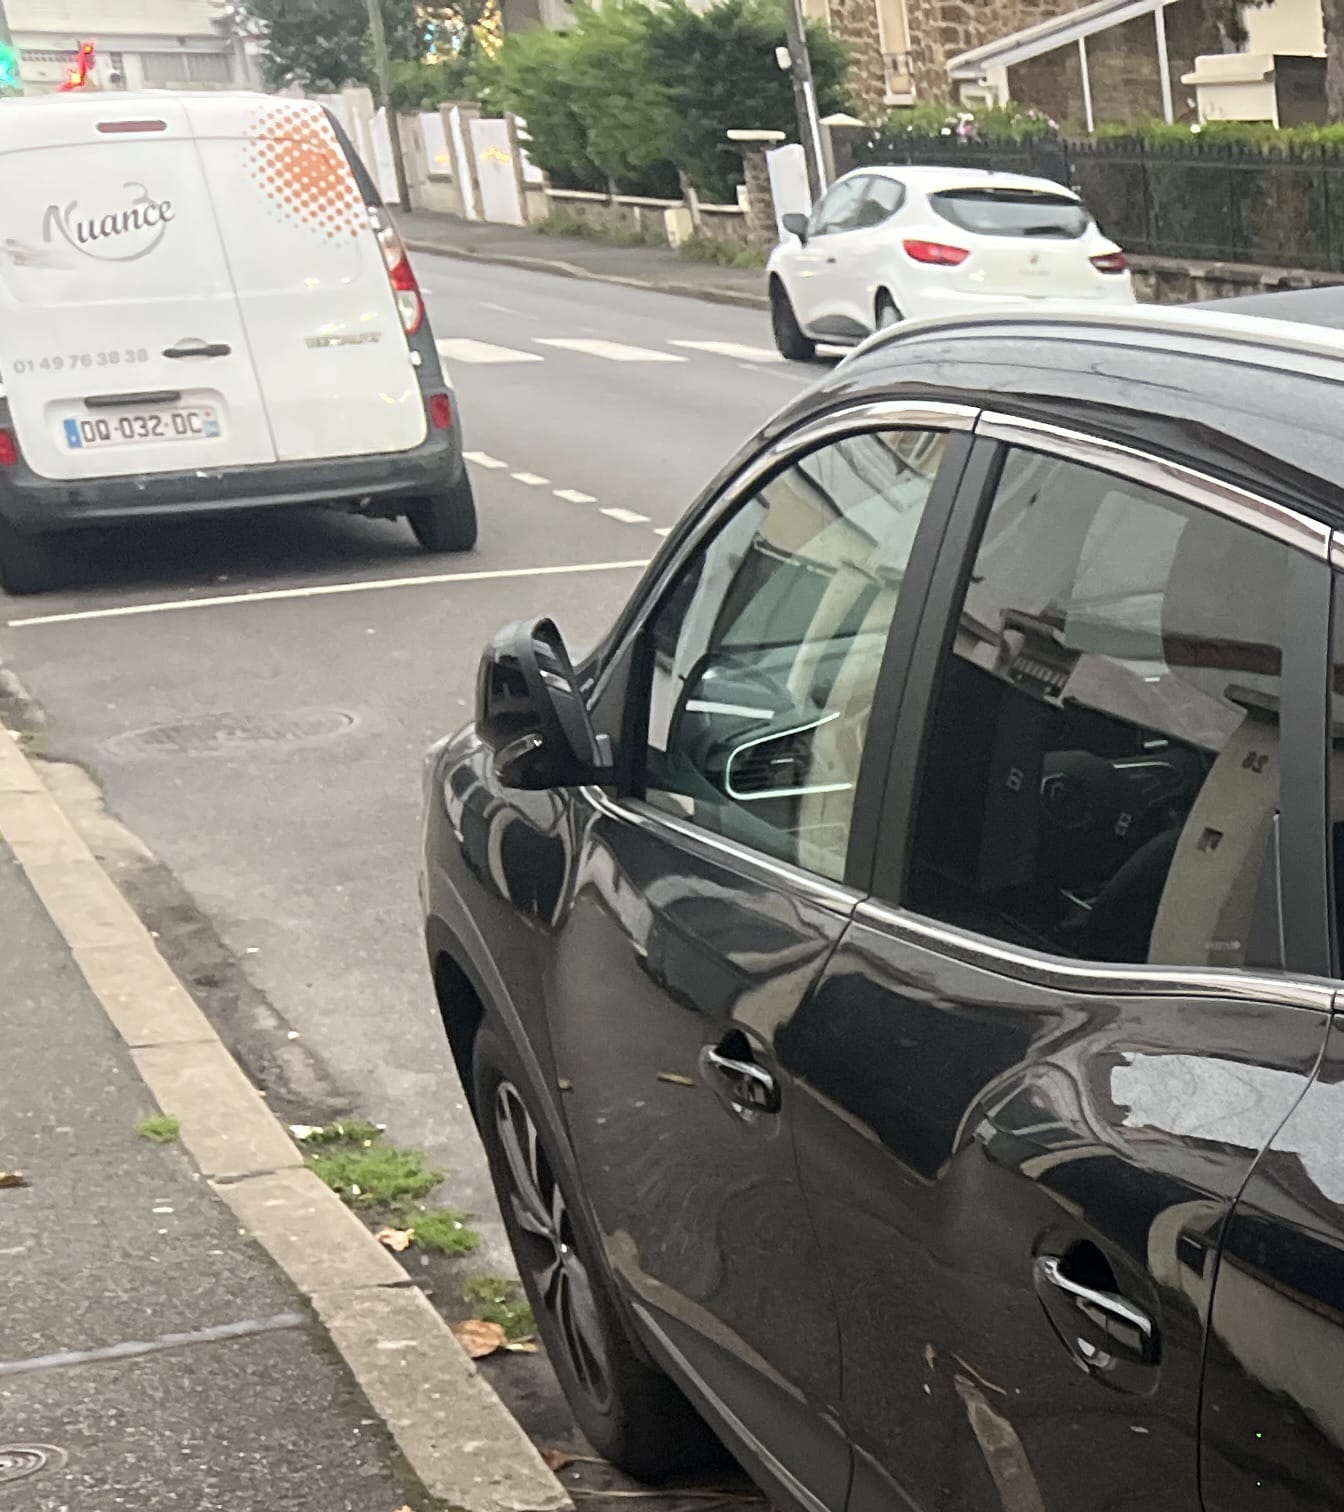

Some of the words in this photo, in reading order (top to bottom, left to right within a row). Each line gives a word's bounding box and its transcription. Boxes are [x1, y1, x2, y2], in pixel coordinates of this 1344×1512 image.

[42, 199, 177, 246] Nuance
[13, 359, 35, 374] 01
[40, 355, 64, 371] 49
[69, 353, 93, 369] 76
[96, 350, 121, 367] 38
